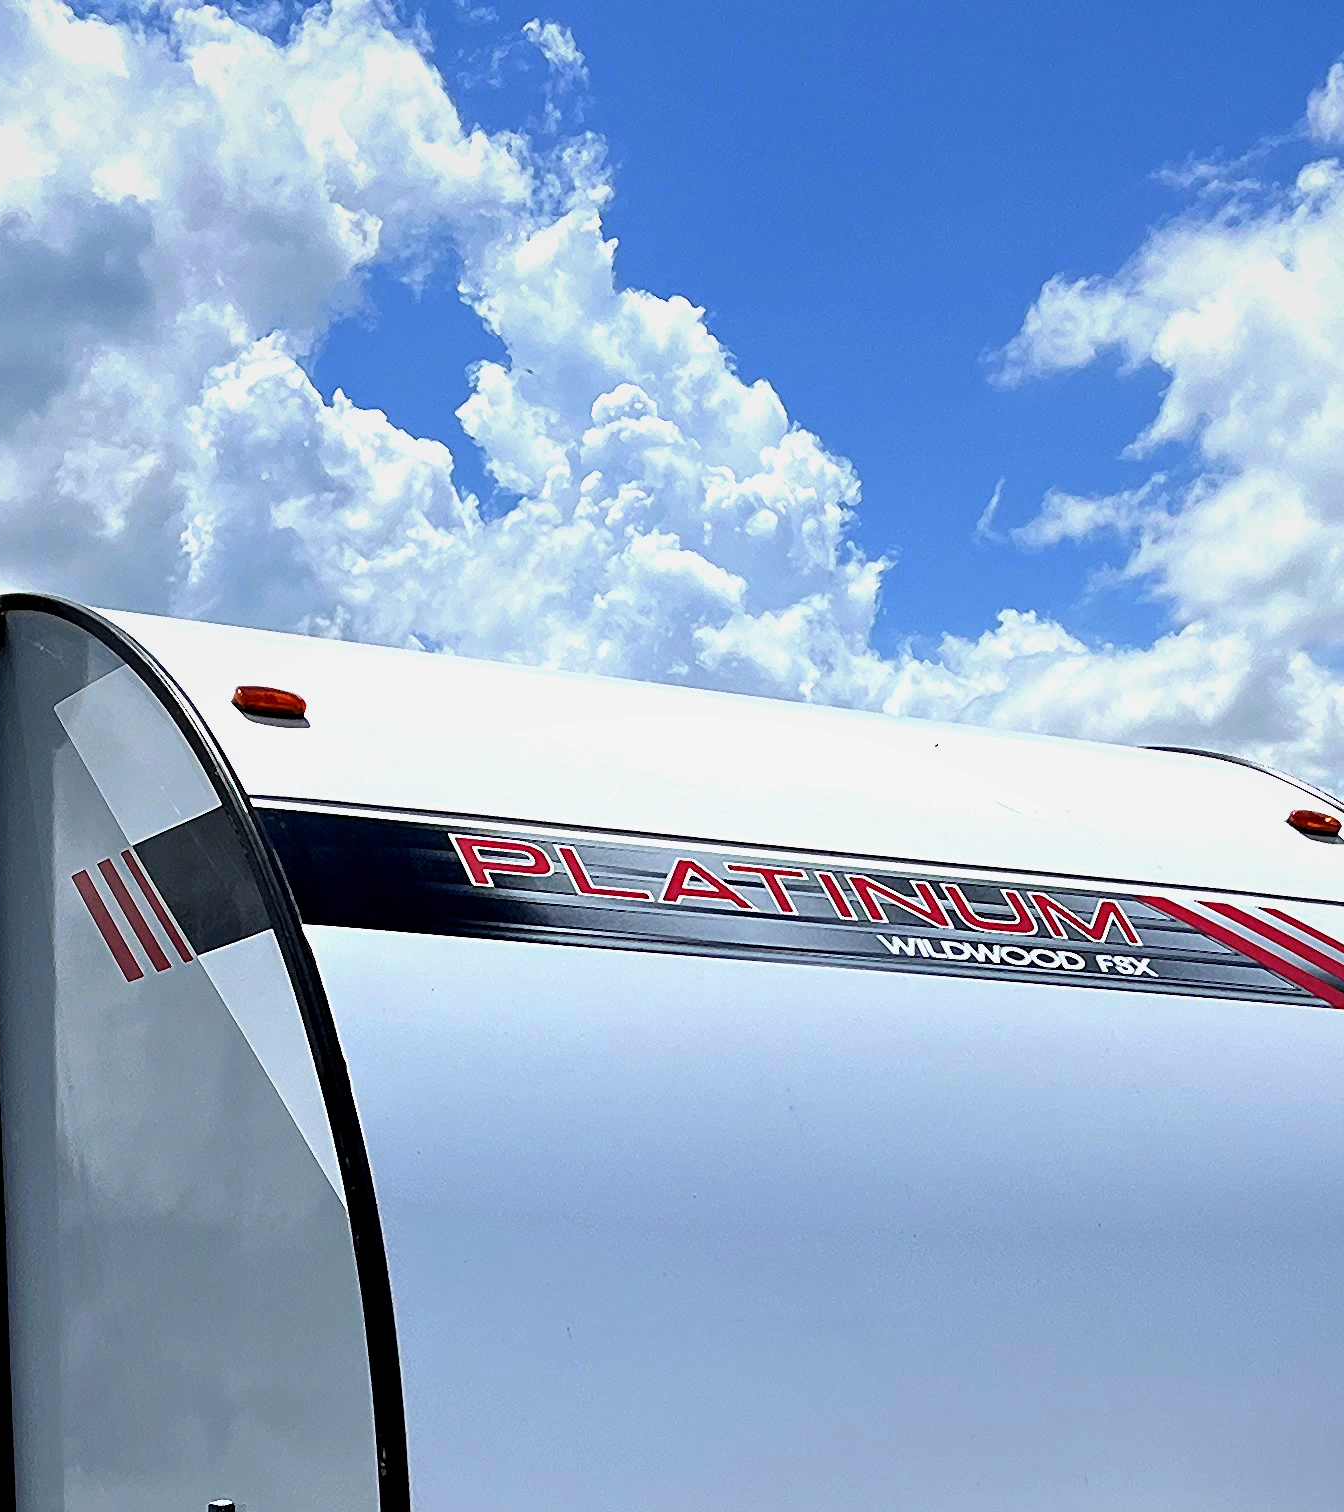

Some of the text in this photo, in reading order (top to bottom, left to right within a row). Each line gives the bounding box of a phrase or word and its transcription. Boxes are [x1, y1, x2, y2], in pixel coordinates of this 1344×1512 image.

[447, 832, 1145, 947] PLATINUM
[875, 934, 1159, 978] WILDWOOD FSX
